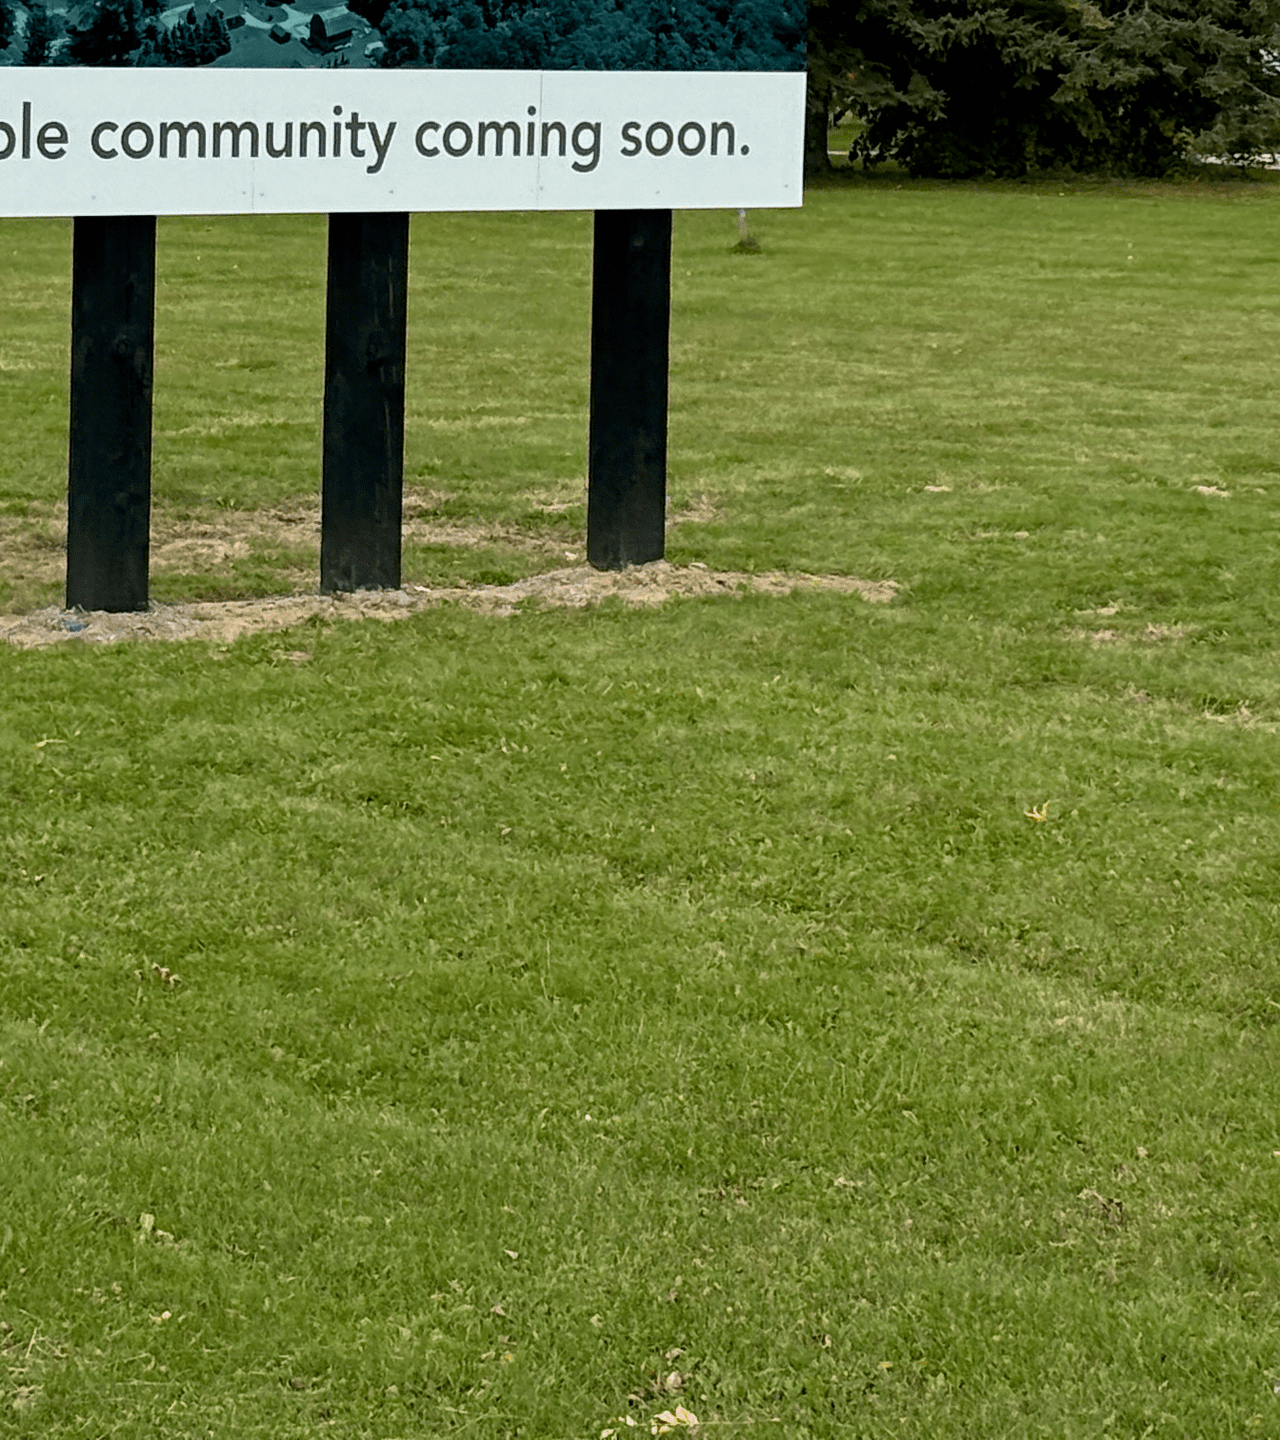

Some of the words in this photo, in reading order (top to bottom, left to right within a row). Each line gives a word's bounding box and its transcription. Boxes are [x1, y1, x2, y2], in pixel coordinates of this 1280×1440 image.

[90, 105, 397, 174] community
[415, 105, 602, 173] coming
[620, 121, 750, 157] soon.
